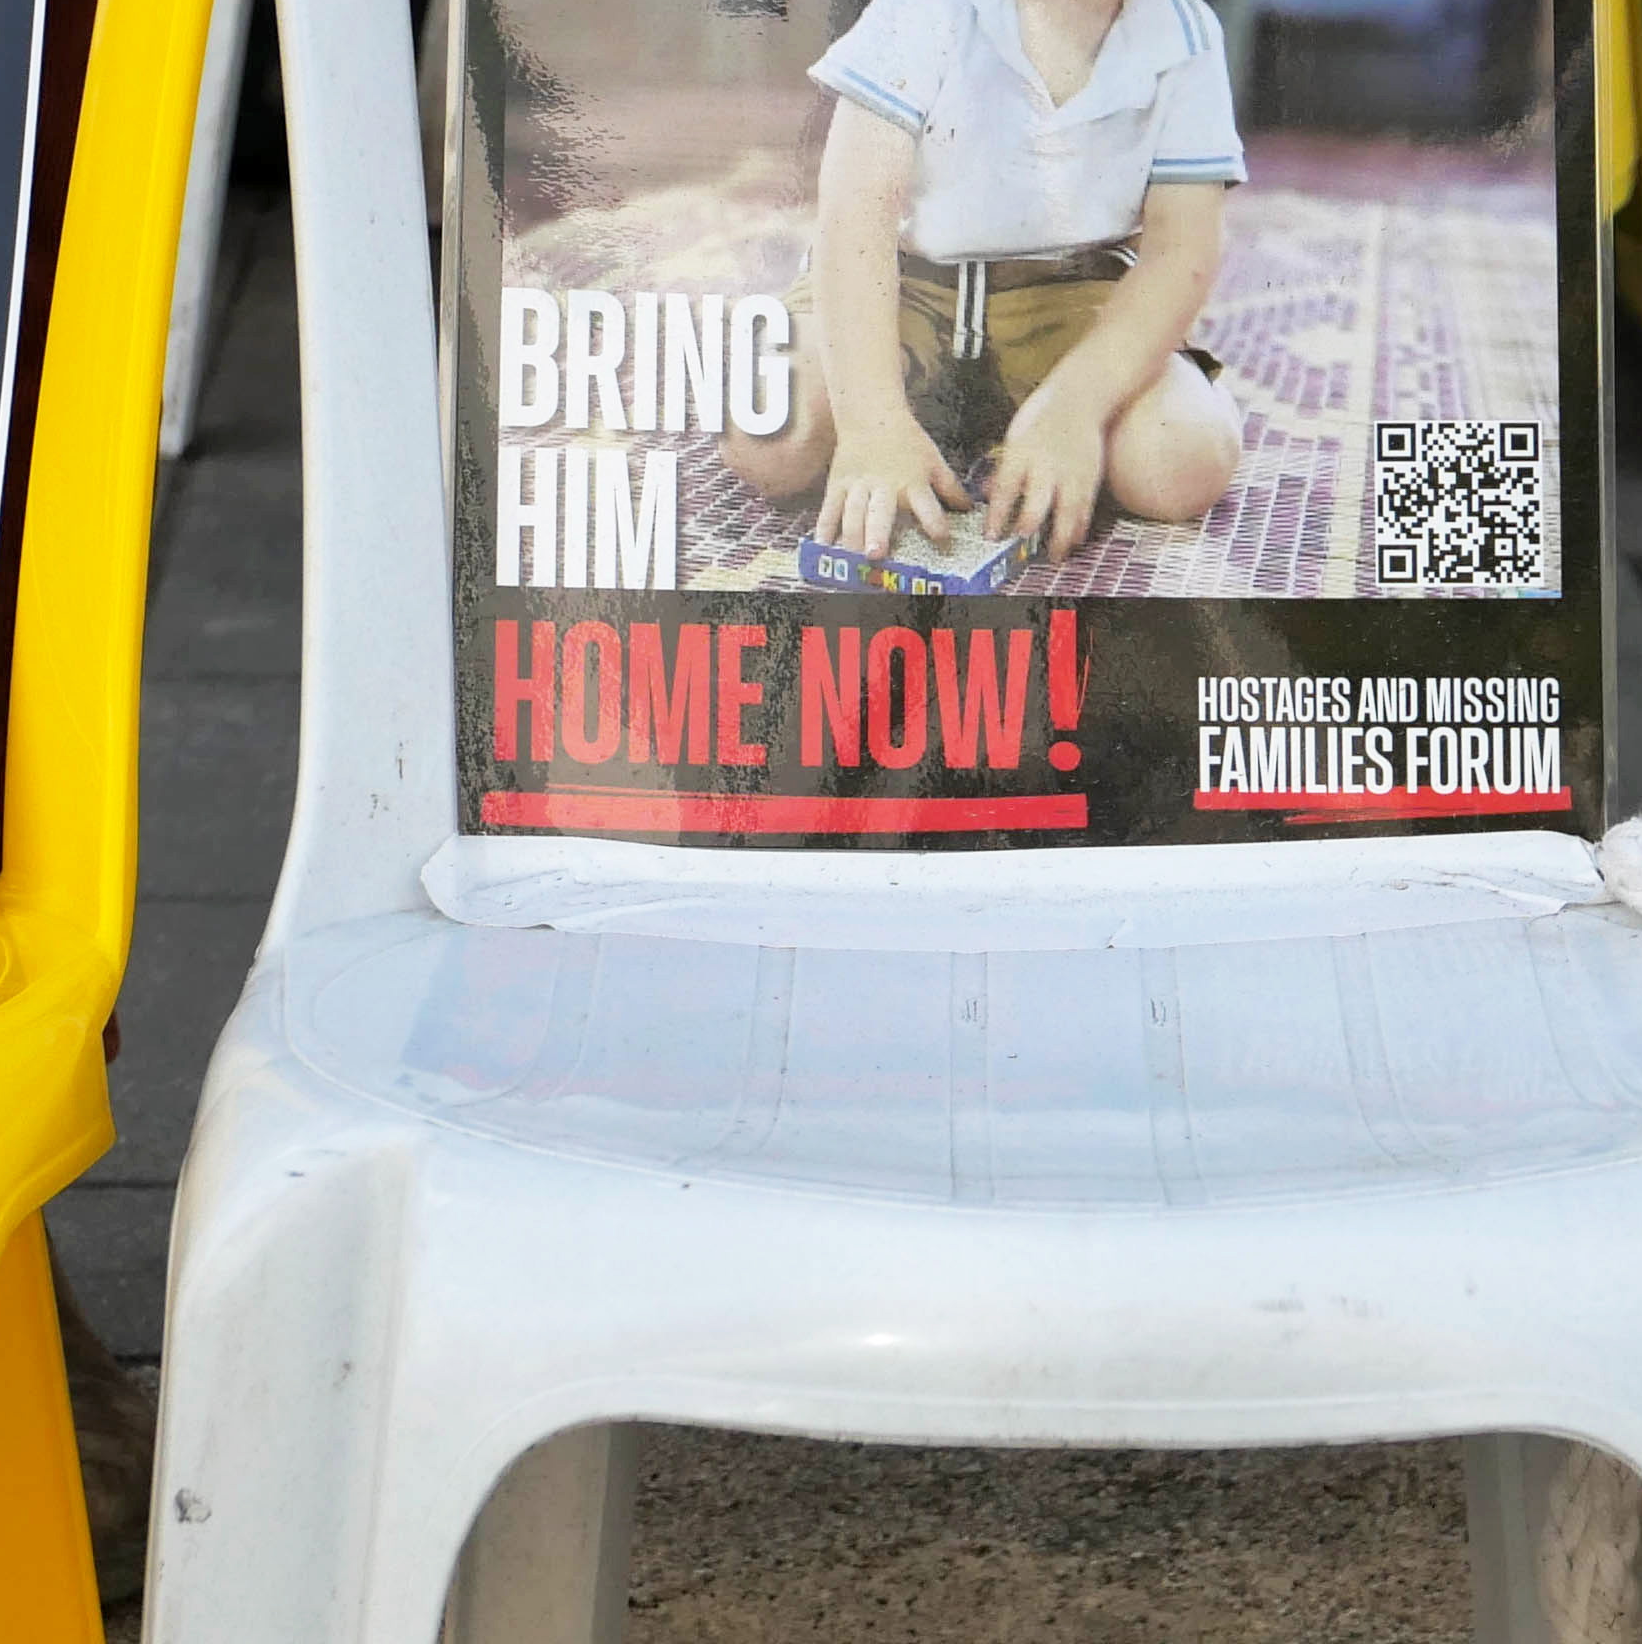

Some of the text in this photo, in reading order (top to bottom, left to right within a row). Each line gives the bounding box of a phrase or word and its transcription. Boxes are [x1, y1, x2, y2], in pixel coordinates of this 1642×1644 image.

[498, 287, 791, 437] BRING
[495, 446, 678, 591] HIM
[493, 609, 1091, 772] HOME NOW!
[1198, 676, 1560, 724] HOSTAGES AND MISSING
[1199, 725, 1561, 795] FAMILIES FORUM
